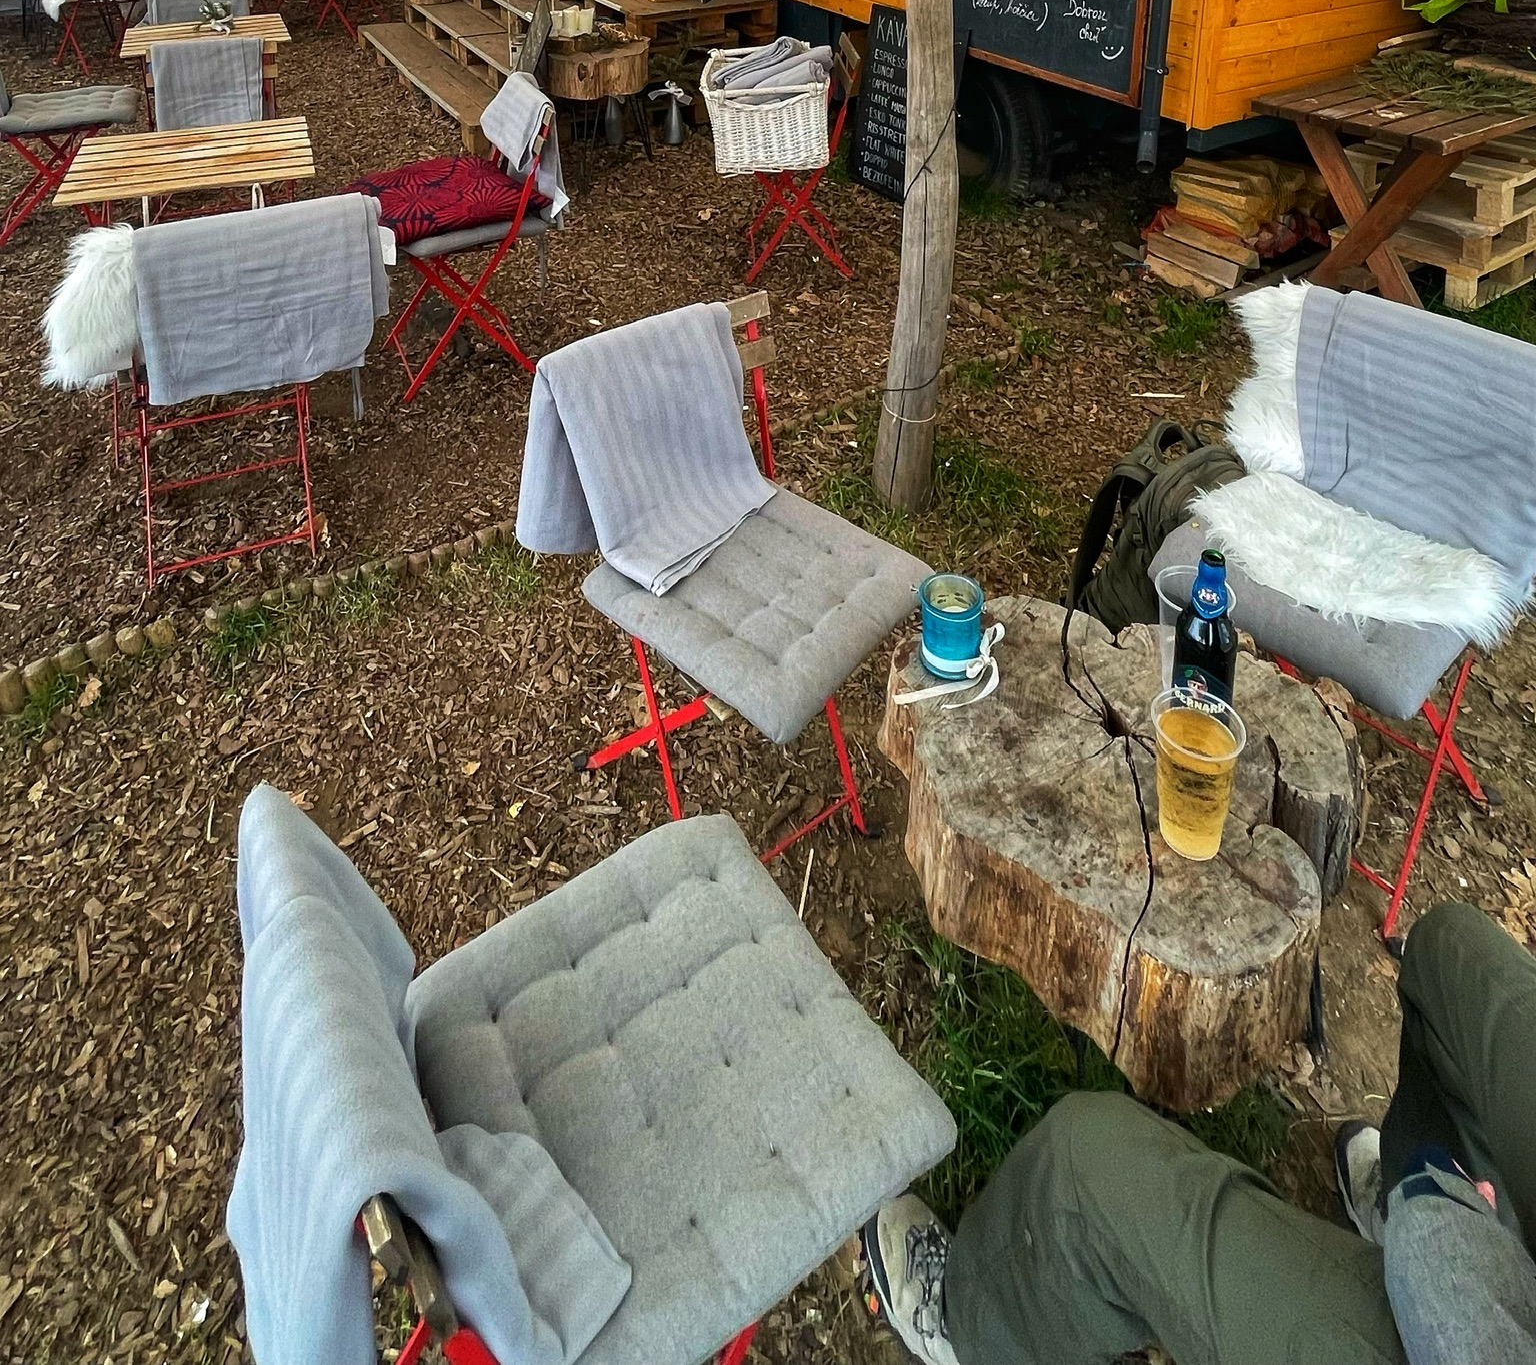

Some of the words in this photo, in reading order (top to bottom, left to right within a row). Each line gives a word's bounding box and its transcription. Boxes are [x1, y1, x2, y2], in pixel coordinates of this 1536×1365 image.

[873, 47, 908, 70] ESPRESS
[870, 77, 907, 100] CAPPUCCIN
[866, 119, 907, 147] RISSTRETT
